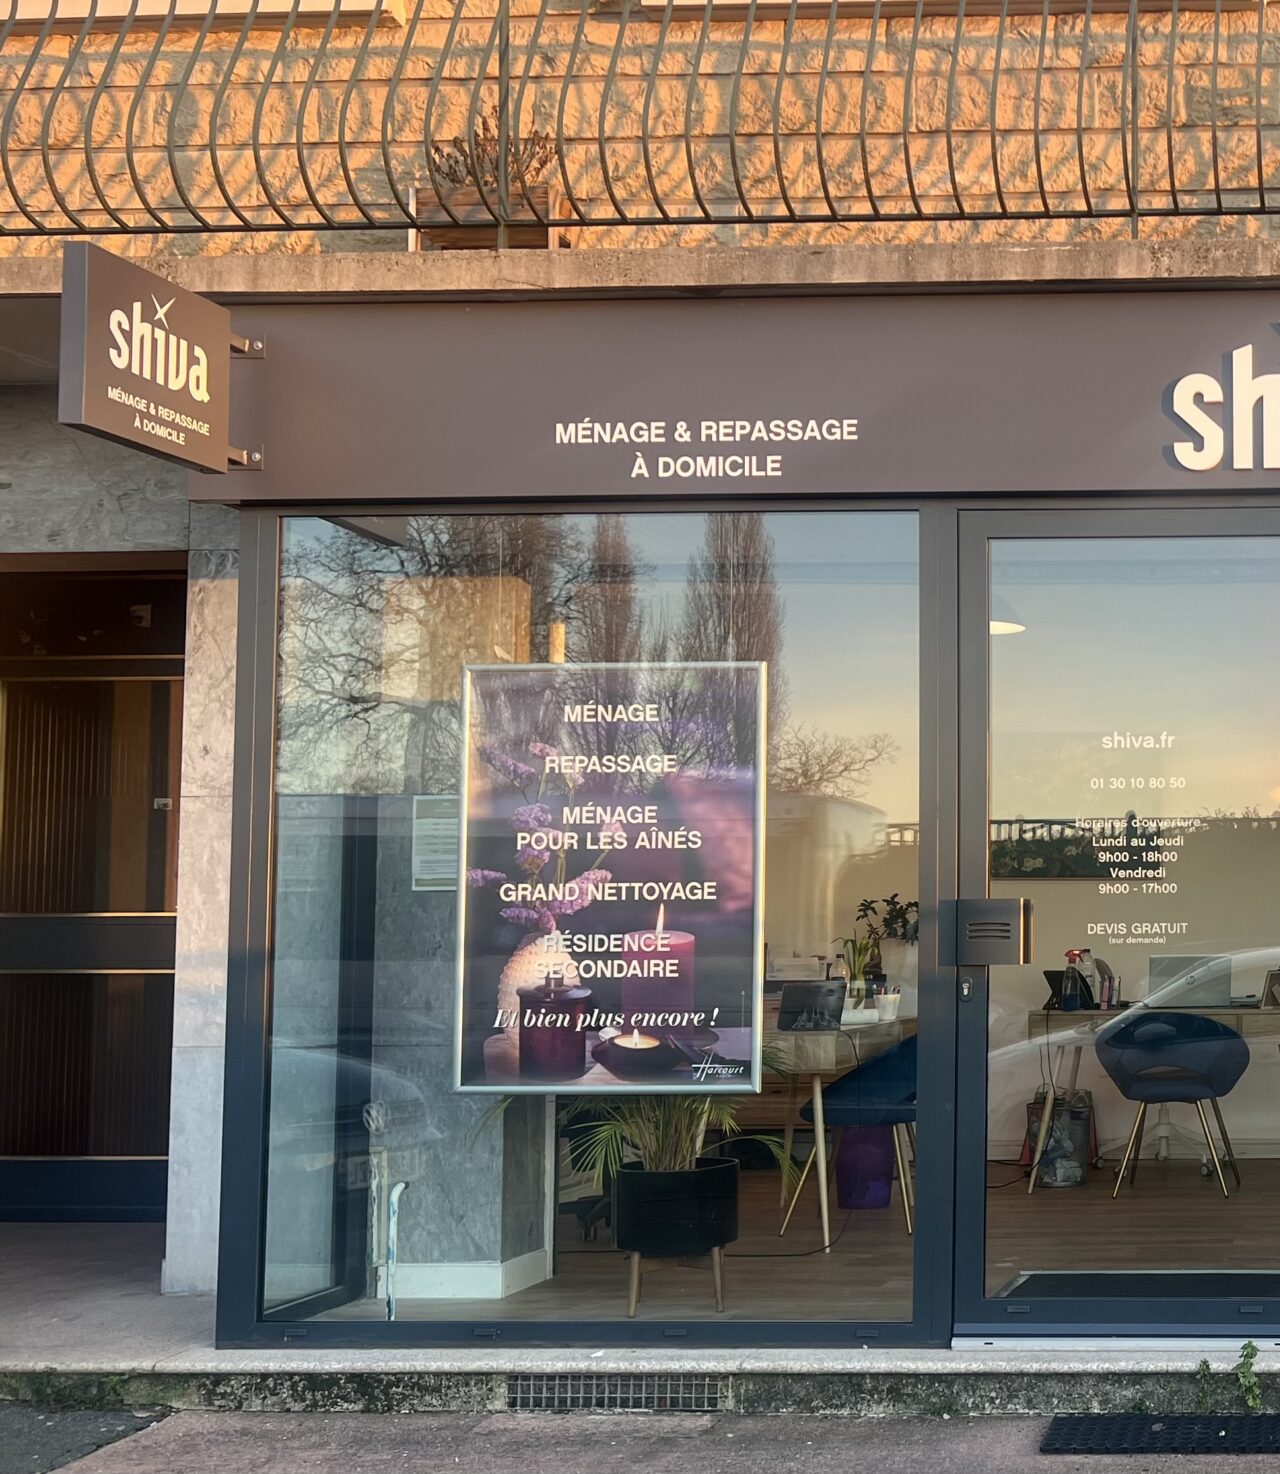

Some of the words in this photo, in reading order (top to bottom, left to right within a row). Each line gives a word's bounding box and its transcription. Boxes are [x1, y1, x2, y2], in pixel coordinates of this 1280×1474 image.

[108, 293, 211, 403] shiva
[107, 385, 148, 411] MÉNAGE
[149, 404, 156, 416] &
[158, 406, 210, 436] REPASSAGE
[133, 413, 141, 429] À
[143, 421, 186, 446] DOMICILE
[555, 417, 666, 444] MÉNAGE
[674, 421, 691, 442] &
[700, 419, 859, 442] REPASSAGE
[631, 452, 649, 478] À
[658, 455, 782, 478] DOMICILE
[563, 700, 659, 723] MÉNAGE
[1101, 731, 1175, 749] shiva.fr
[545, 755, 677, 774] REPASSAGE
[1090, 778, 1104, 789] 01
[1109, 778, 1126, 789] 30
[1131, 778, 1144, 789] 10
[1149, 777, 1165, 789] 80
[1170, 777, 1186, 789] 50
[562, 802, 658, 825] MÉNAGE
[1075, 817, 1127, 828] Horaires
[516, 832, 579, 850] POUR
[586, 831, 628, 850] LES
[634, 826, 702, 849] AÎNÉS
[1092, 836, 1127, 847] Lundi
[1130, 838, 1145, 847] au
[1149, 836, 1184, 847] Jeudi
[1098, 852, 1130, 862] 9h00
[1141, 851, 1178, 862] 18h00
[1109, 867, 1166, 878] Vendredi
[499, 882, 580, 902] GRAND
[587, 881, 717, 900] NETTOYAGE
[1098, 883, 1130, 894] 9h00
[1141, 883, 1178, 894] 17h00
[1087, 923, 1127, 934] DEVIS
[1131, 922, 1188, 934] GRATUIT
[544, 930, 671, 953] RÉSIDENCE
[1108, 936, 1124, 944] (sur
[1126, 936, 1166, 944] demande)
[534, 960, 679, 978] SECONDAIRE
[523, 1008, 571, 1027] bien
[575, 1008, 625, 1031] plus
[630, 1009, 705, 1028] encore
[709, 1007, 720, 1026] !
[692, 1050, 744, 1081] Harcourt
